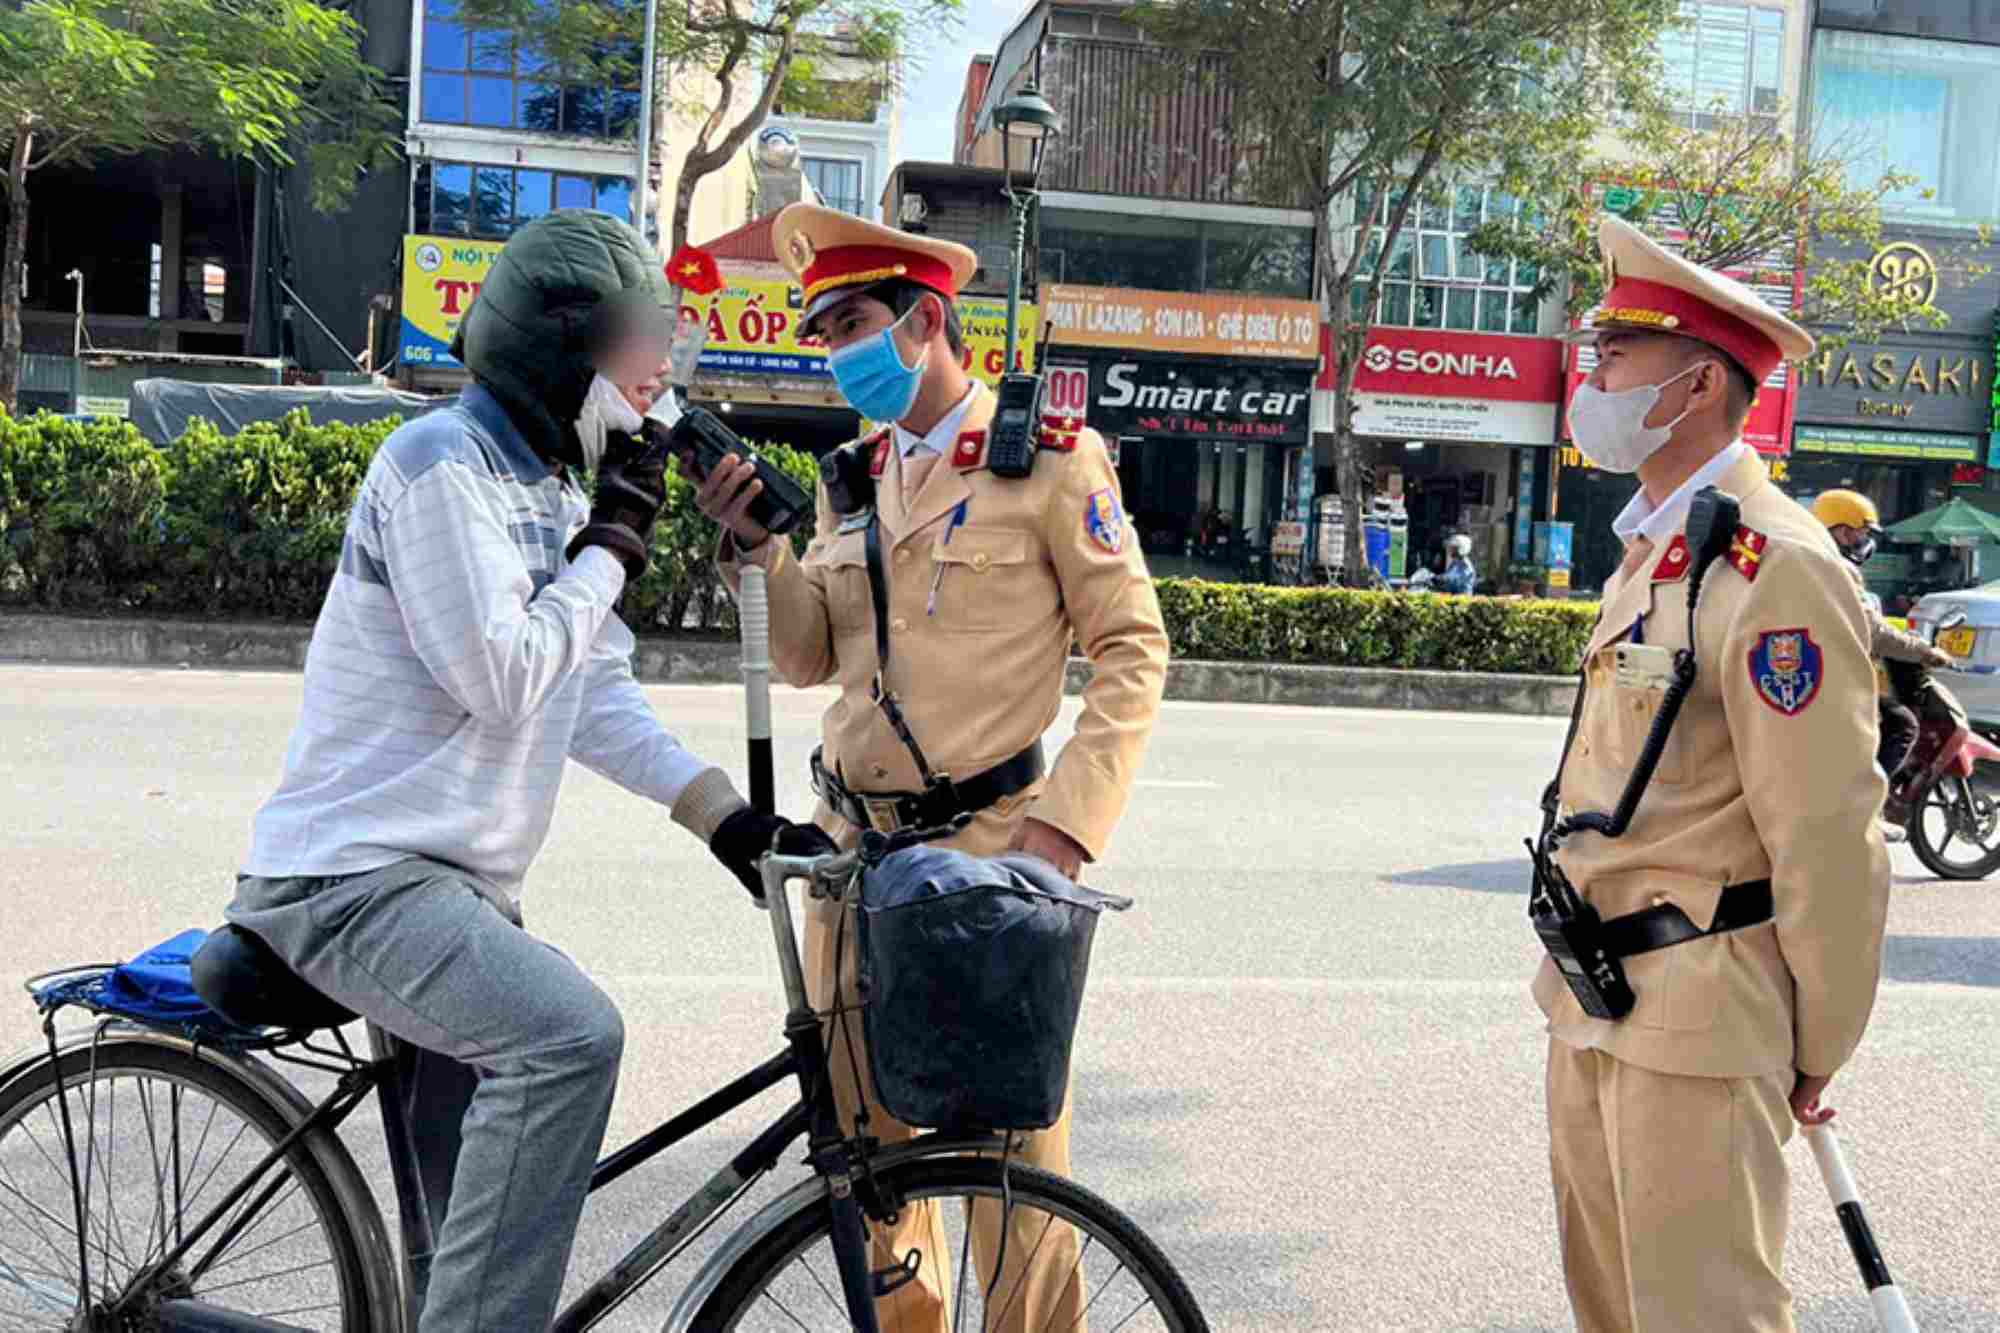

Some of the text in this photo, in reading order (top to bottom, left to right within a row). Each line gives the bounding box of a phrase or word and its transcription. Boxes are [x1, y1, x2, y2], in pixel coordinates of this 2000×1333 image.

[1395, 349, 1519, 379] SONHA
[1098, 363, 1306, 416] Smart car
